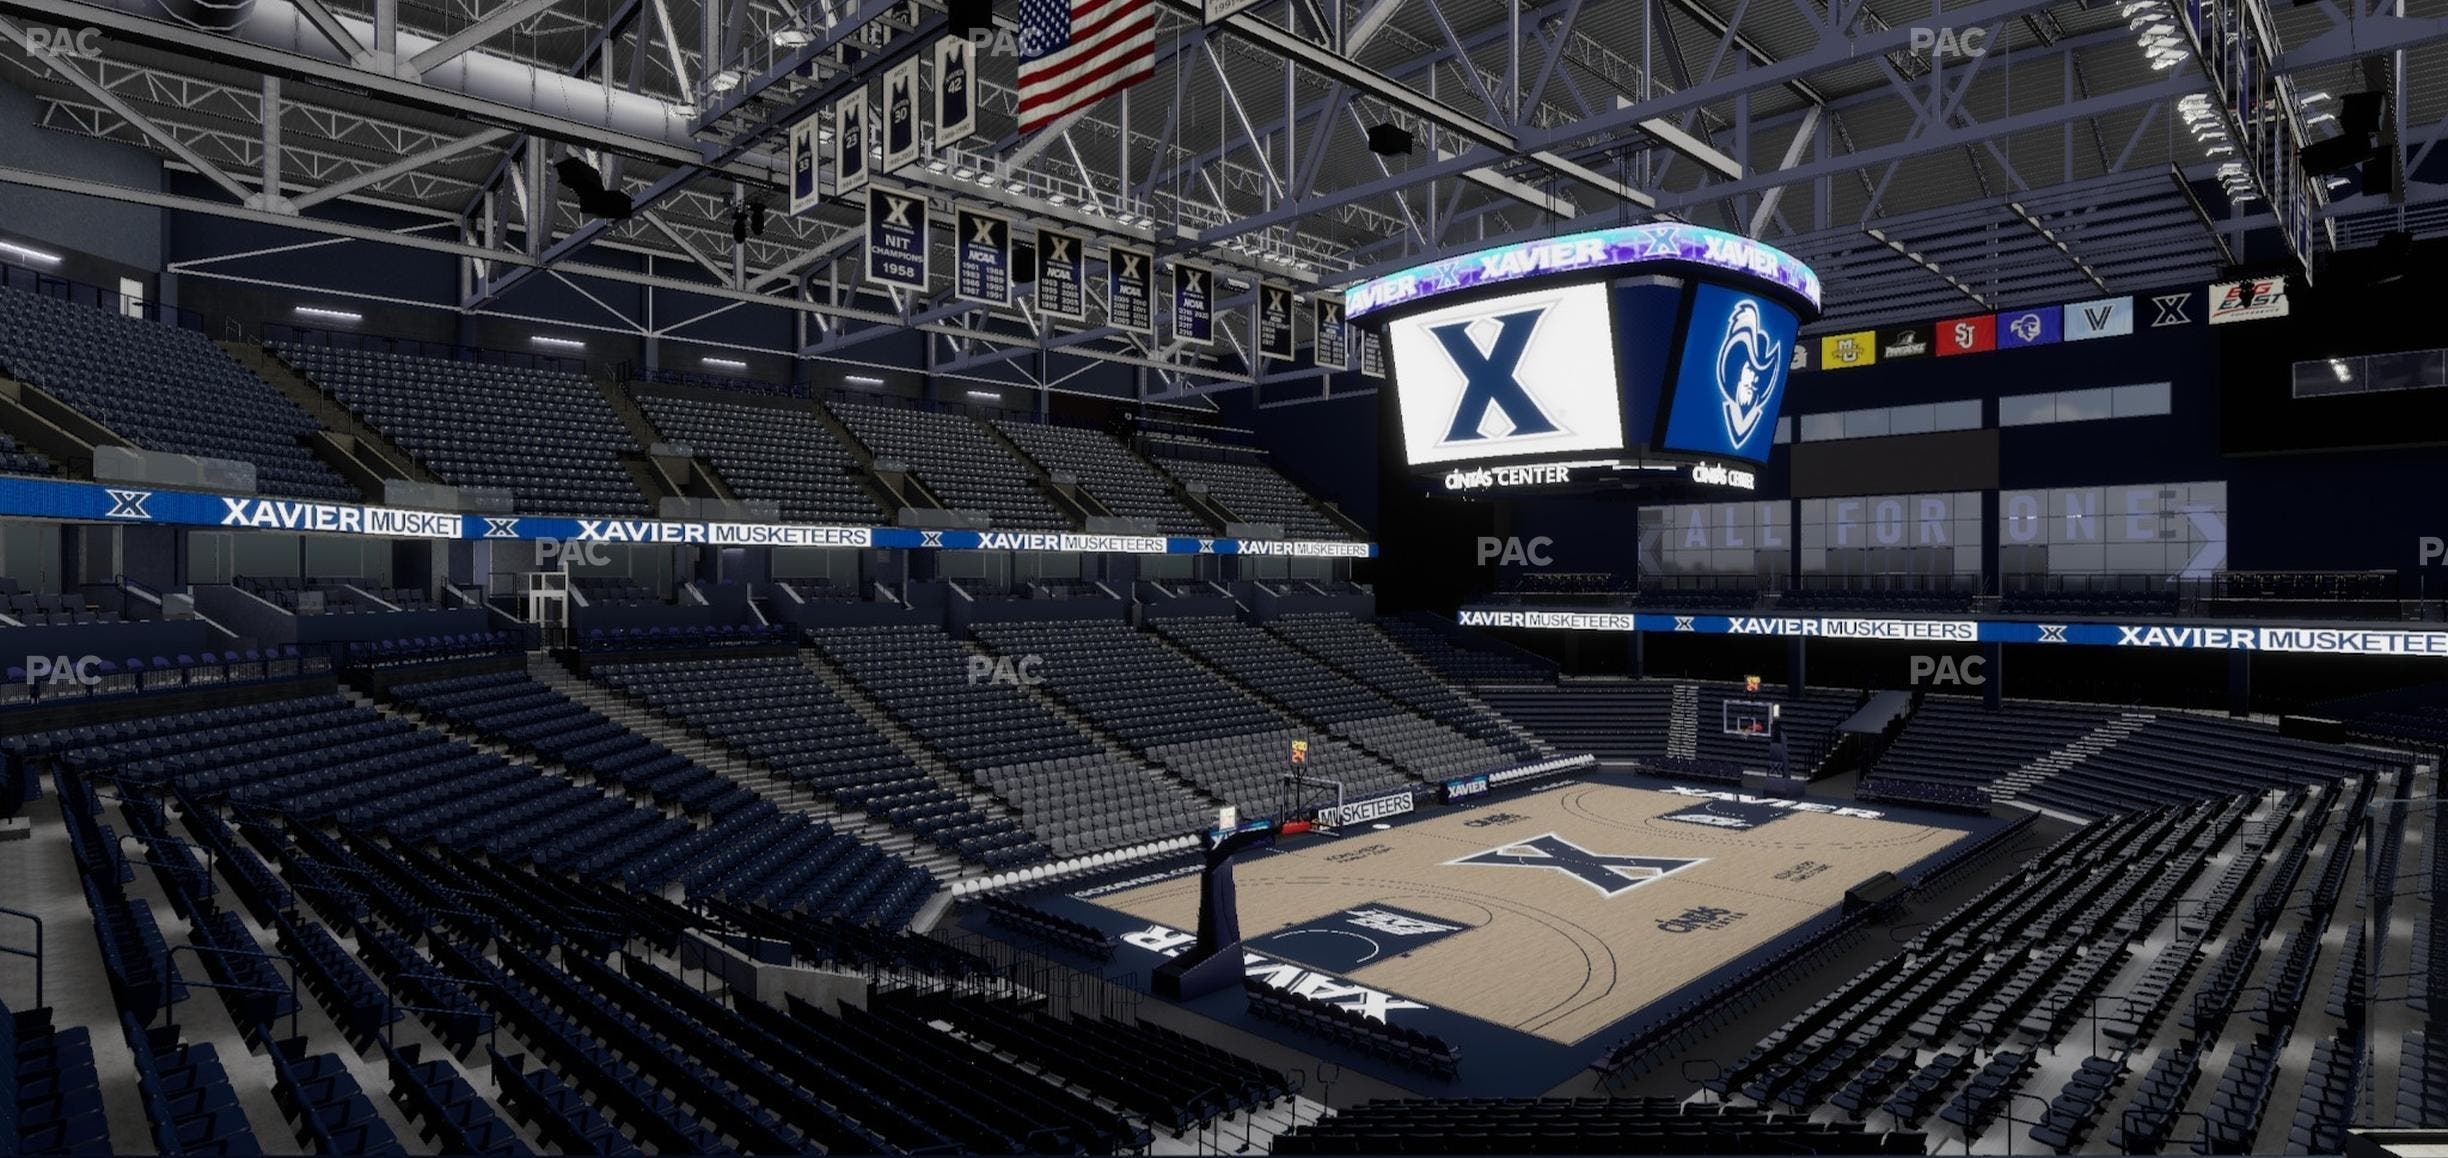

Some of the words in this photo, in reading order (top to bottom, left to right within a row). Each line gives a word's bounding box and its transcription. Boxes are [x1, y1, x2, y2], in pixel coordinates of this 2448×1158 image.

[948, 77, 962, 94] 42
[894, 107, 908, 124] 30
[846, 133, 858, 150] 23
[882, 196, 912, 228] X
[885, 233, 912, 250] NIT
[972, 217, 997, 247] X
[871, 245, 924, 263] CHAMPIONS
[968, 249, 997, 265] NCAA
[1050, 236, 1071, 264] X
[1480, 239, 1607, 279] XAVIER
[1703, 236, 1779, 278] XAVIER
[883, 262, 915, 278] 1958
[1047, 267, 1072, 280] NCAA
[1122, 254, 1141, 281] X
[1119, 285, 1143, 298] NCAA
[1185, 269, 1204, 294] X
[1183, 298, 1205, 311] NCAA
[1269, 288, 1286, 313] X
[2151, 292, 2193, 328] X
[1325, 302, 1339, 325] X
[1420, 299, 1574, 447] X
[1498, 465, 1569, 486] CENTER
[1728, 469, 1755, 489] CENTER
[105, 489, 152, 519] X
[221, 497, 362, 532] XAVIER
[371, 510, 461, 537] MUSKET
[483, 518, 520, 538] X
[577, 519, 706, 544] XAVIER
[714, 525, 867, 546] MUSKETEERS
[920, 530, 942, 547] X
[978, 532, 1059, 551] XAVIER
[1064, 536, 1165, 552] MUSKETEERS
[1237, 541, 1293, 555] XAVIER
[1298, 543, 1368, 557] MUSKETEERS
[1685, 507, 1782, 548] ALL
[1837, 501, 1947, 545] FOR
[2008, 490, 2155, 541] ONE
[1459, 610, 1524, 627] XAVIER
[1528, 614, 1631, 630] MUSKETEERS
[1728, 616, 1819, 636] XAVIER
[1826, 620, 1973, 640] MUSKETEERS
[2038, 624, 2067, 643] X
[2117, 625, 2257, 649] XAVIER
[1448, 779, 1489, 800] XAVIER
[1438, 832, 1709, 899] X
